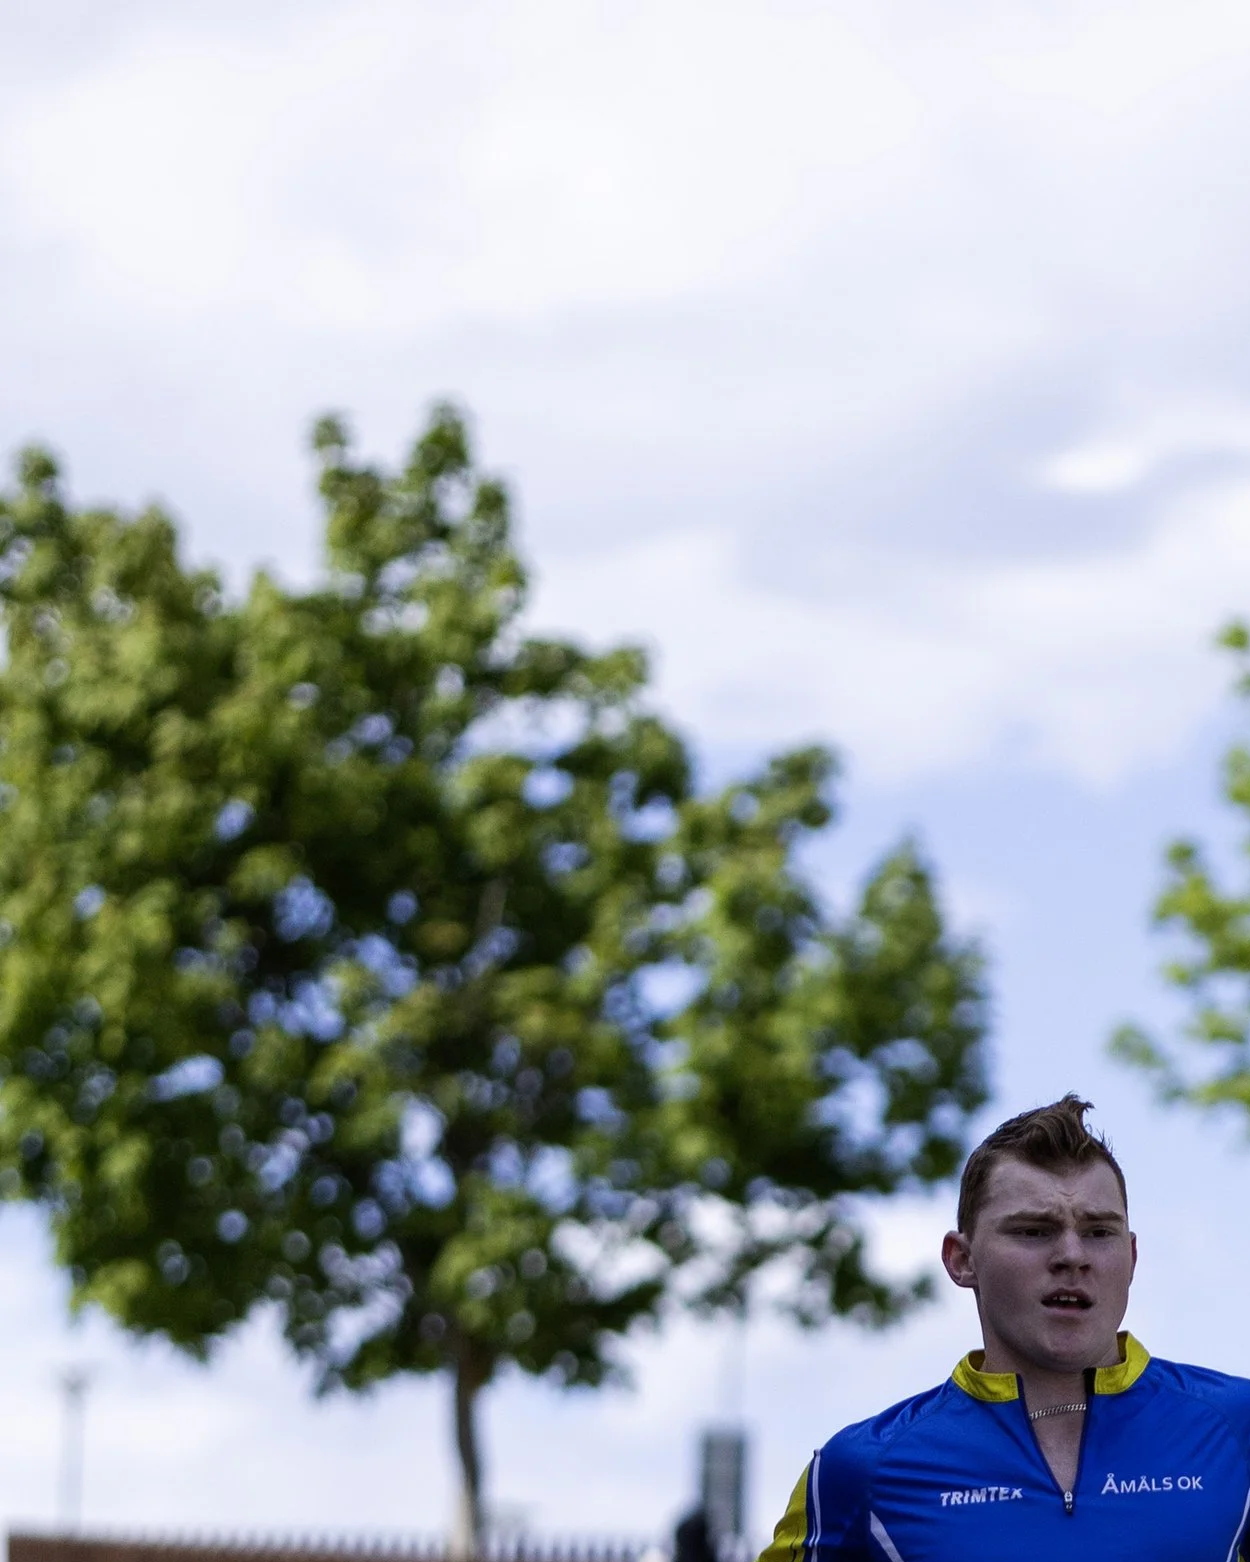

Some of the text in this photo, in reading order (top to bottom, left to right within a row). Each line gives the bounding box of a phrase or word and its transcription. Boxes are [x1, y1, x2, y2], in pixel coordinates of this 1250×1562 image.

[1101, 1473, 1204, 1495] ÅMÅLS OK
[940, 1486, 1023, 1507] TRIMTEX
